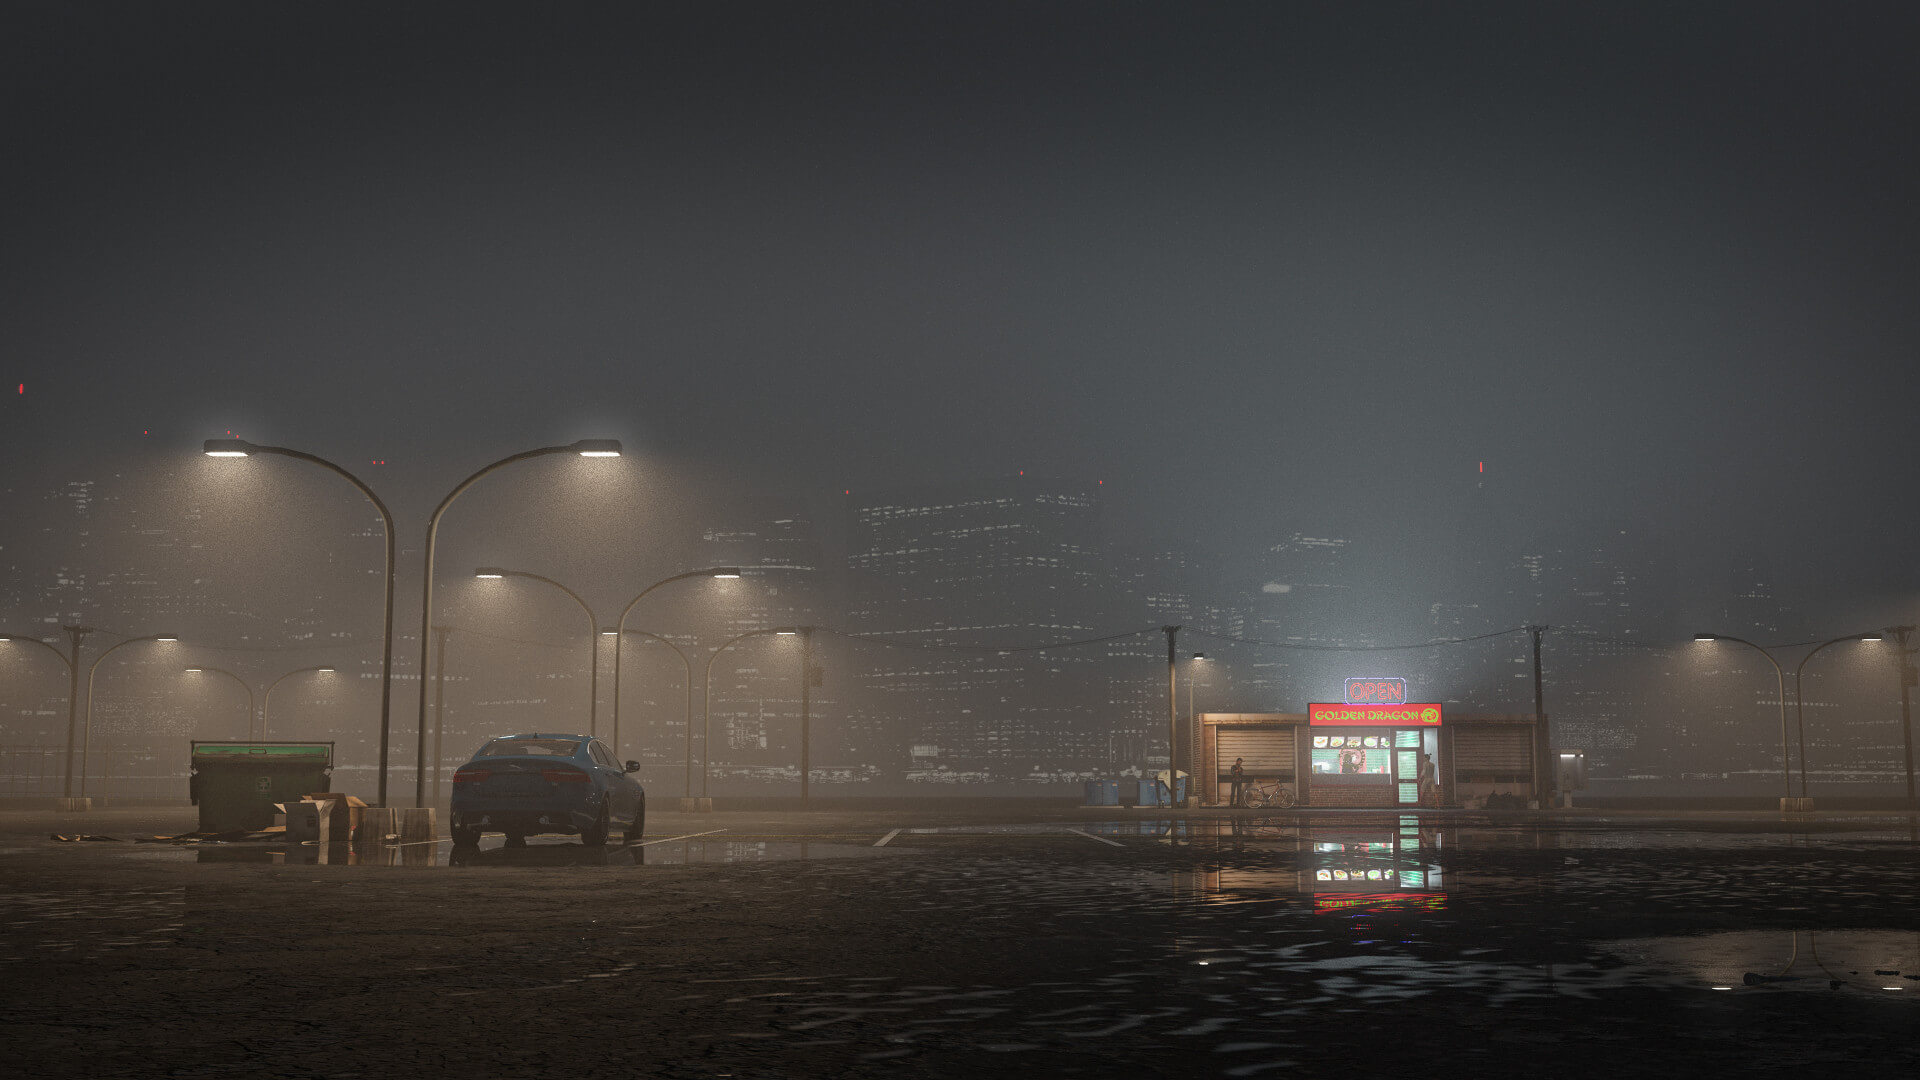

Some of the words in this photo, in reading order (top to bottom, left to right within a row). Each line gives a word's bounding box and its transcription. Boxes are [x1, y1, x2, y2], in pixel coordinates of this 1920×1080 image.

[1349, 682, 1402, 700] OPEN
[1314, 710, 1365, 721] GOLDEN
[1367, 710, 1419, 721] DRAGON
